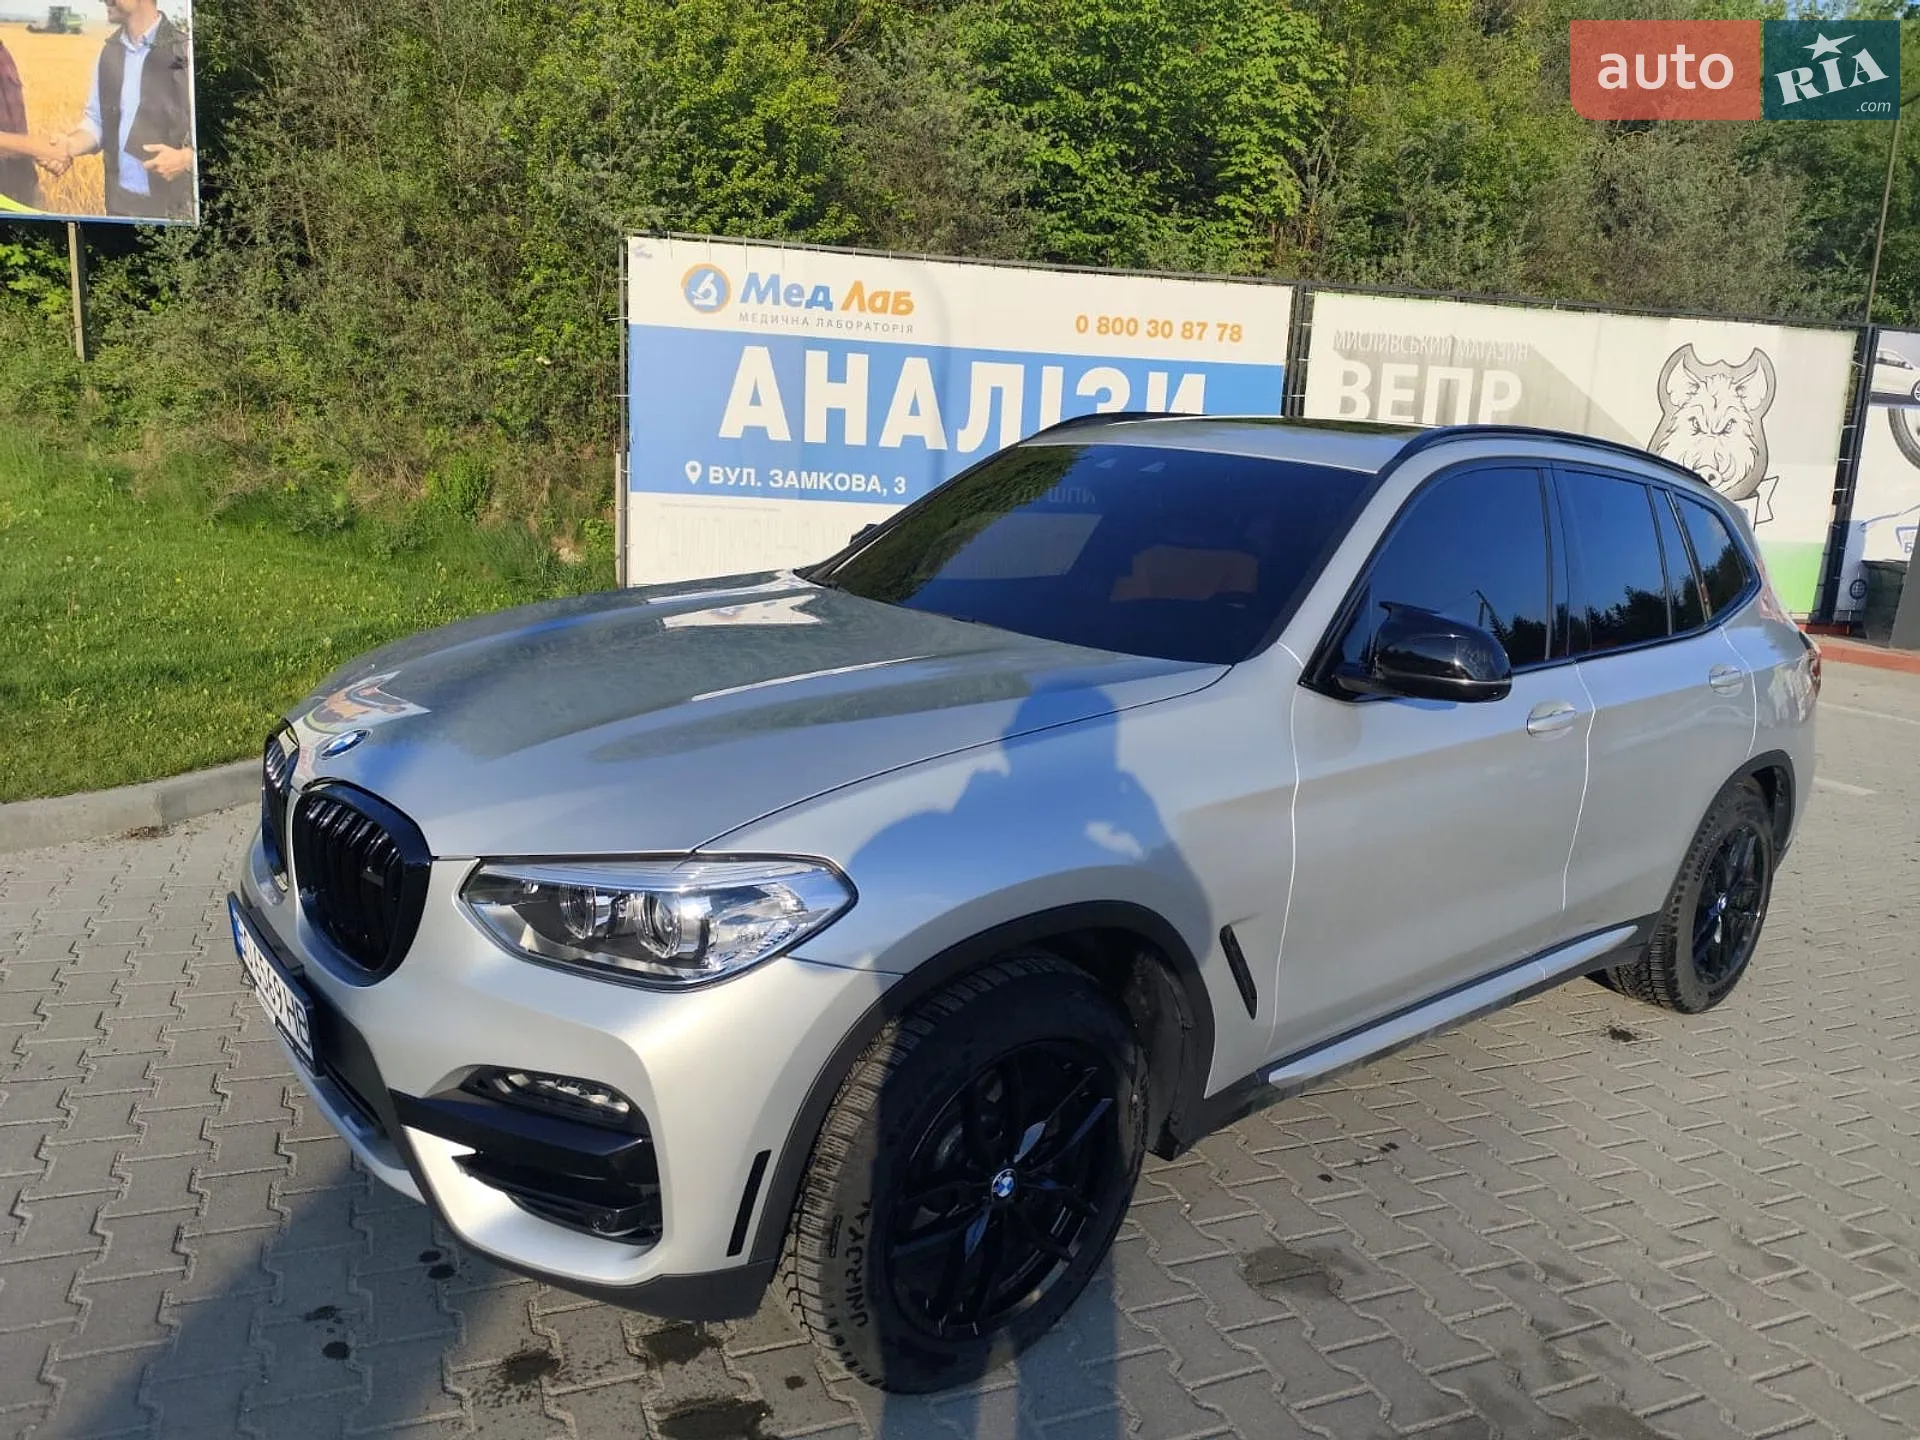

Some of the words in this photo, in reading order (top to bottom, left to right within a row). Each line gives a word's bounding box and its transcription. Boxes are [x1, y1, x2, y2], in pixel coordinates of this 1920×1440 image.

[739, 272, 834, 311] Мед
[840, 280, 914, 316] Лаб
[739, 312, 810, 327] МЕДИЧНА
[815, 316, 914, 334] ЛАБОРАТОРІЯ
[1075, 315, 1089, 334] 0
[1096, 316, 1139, 337] 800
[1146, 319, 1174, 339] 30
[1181, 321, 1209, 341] 87
[1216, 322, 1243, 343] 78
[1336, 360, 1522, 425] ВЕПР
[708, 465, 762, 487] ВУЛ.
[769, 469, 888, 497] ЗАМКОВА,
[893, 476, 906, 494] 3
